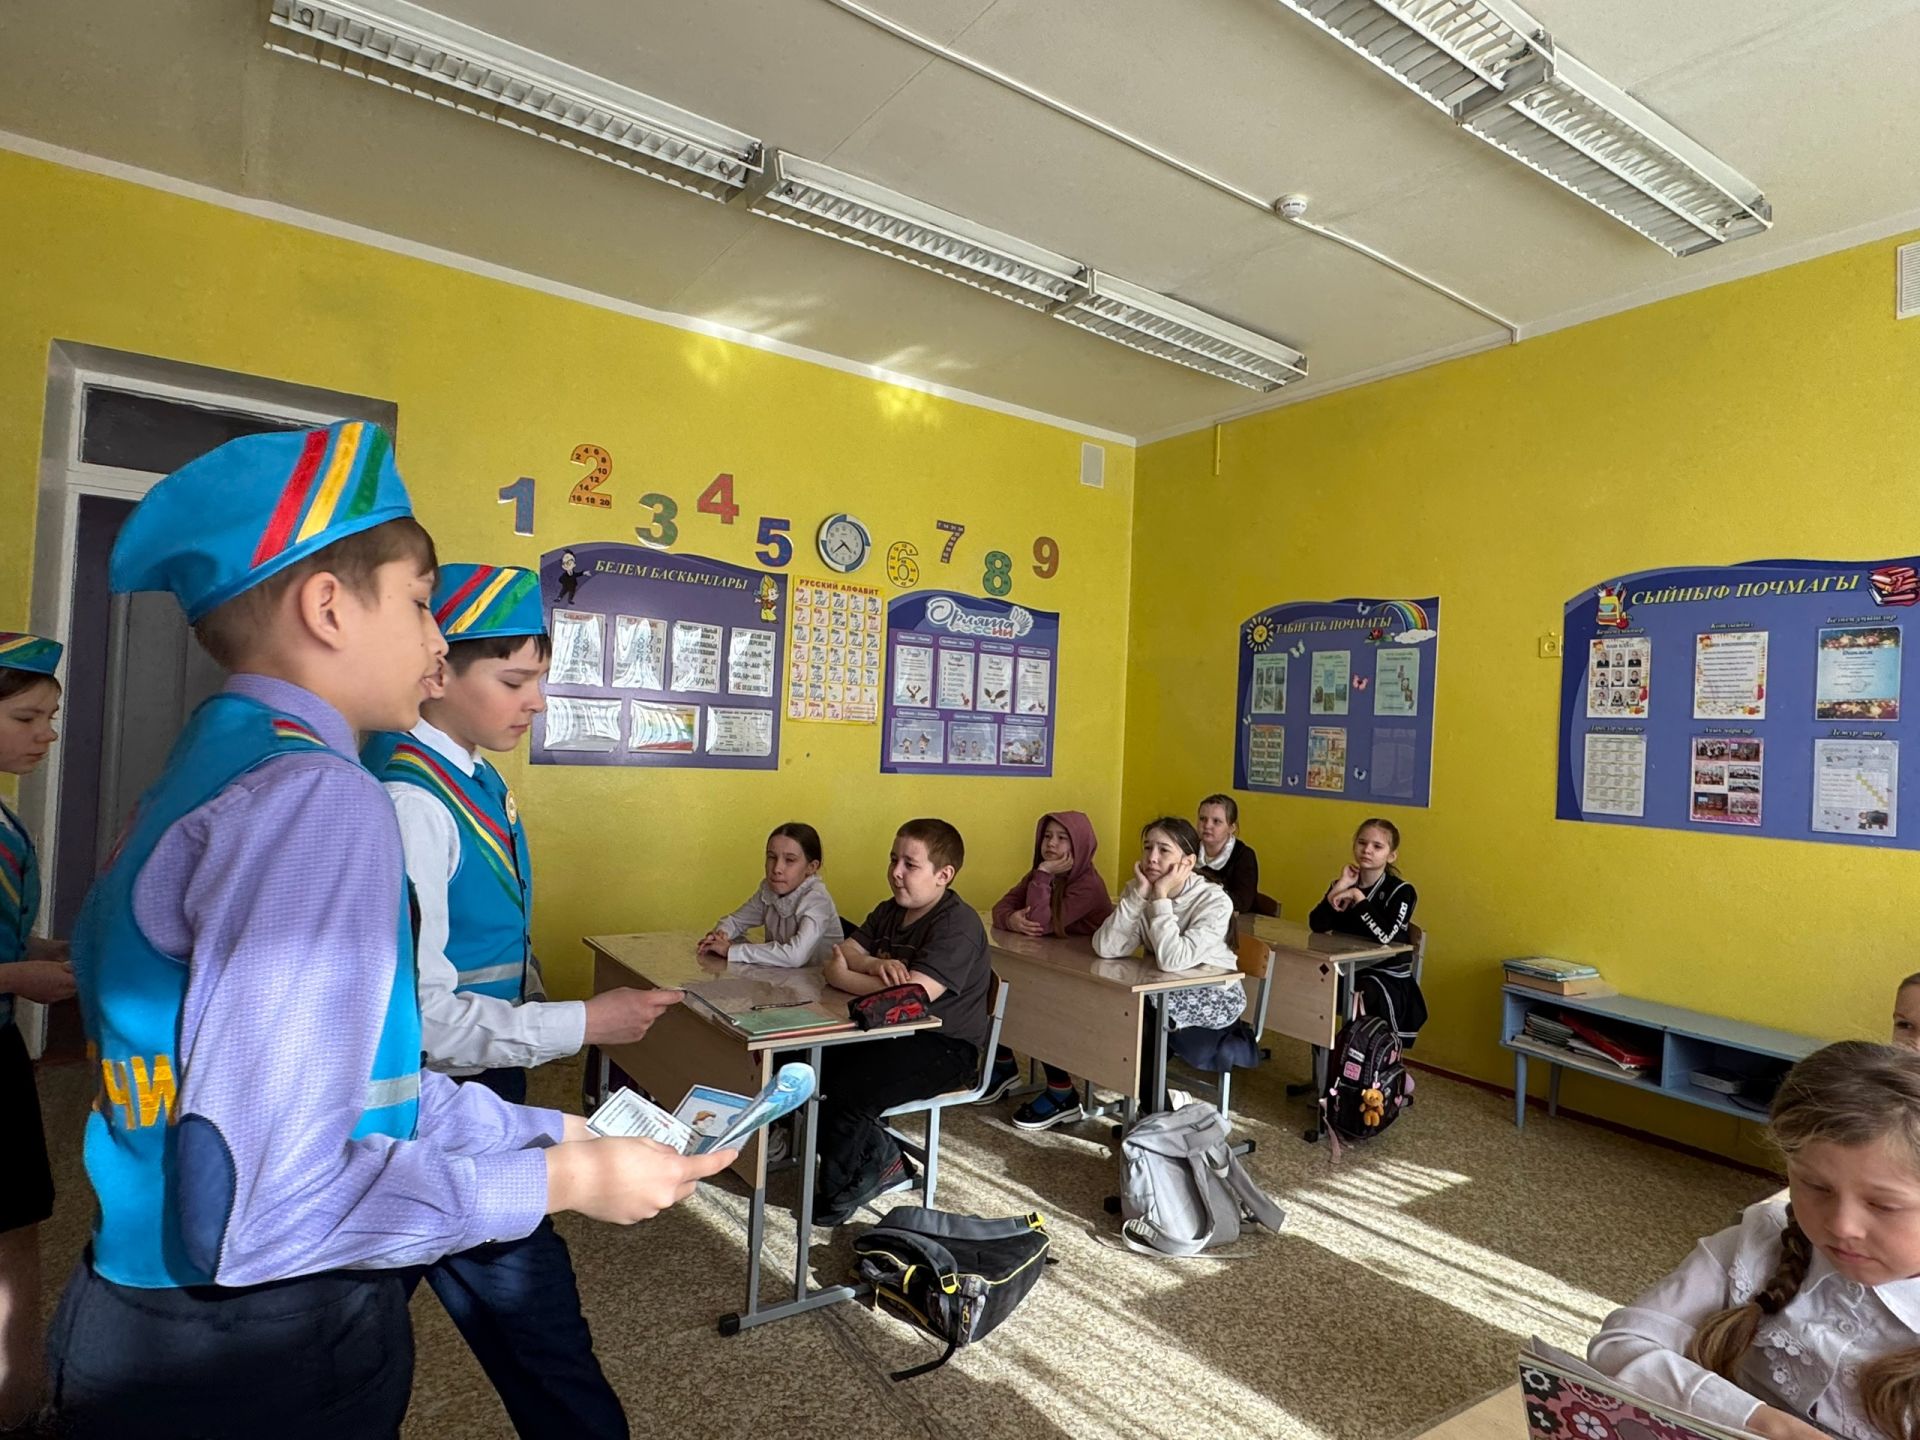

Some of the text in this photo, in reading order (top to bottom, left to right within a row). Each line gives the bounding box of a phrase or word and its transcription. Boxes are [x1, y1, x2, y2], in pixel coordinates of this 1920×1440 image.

[569, 443, 612, 508] 2
[590, 475, 600, 483] 12
[598, 467, 607, 475] 10
[498, 477, 535, 536] 1
[697, 473, 740, 525] 4
[635, 493, 678, 549] 3
[755, 516, 793, 567] 5
[936, 520, 965, 564] 7
[594, 560, 749, 590] БЕЛЕМ БАСКЫЧЛАРЫ
[887, 541, 919, 588] 6
[983, 551, 1012, 596] 8
[1032, 536, 1060, 579] 9
[799, 579, 879, 596] РУССКИЙ АЛФАВИТ
[1632, 575, 1860, 606] СЫЙНЫФ ПОЧМАГЫ
[930, 599, 1014, 627] Орлята
[955, 624, 1013, 637] ОССИИ
[1275, 616, 1392, 634] ТАБИГАТЬ ПОЧМАГЫ
